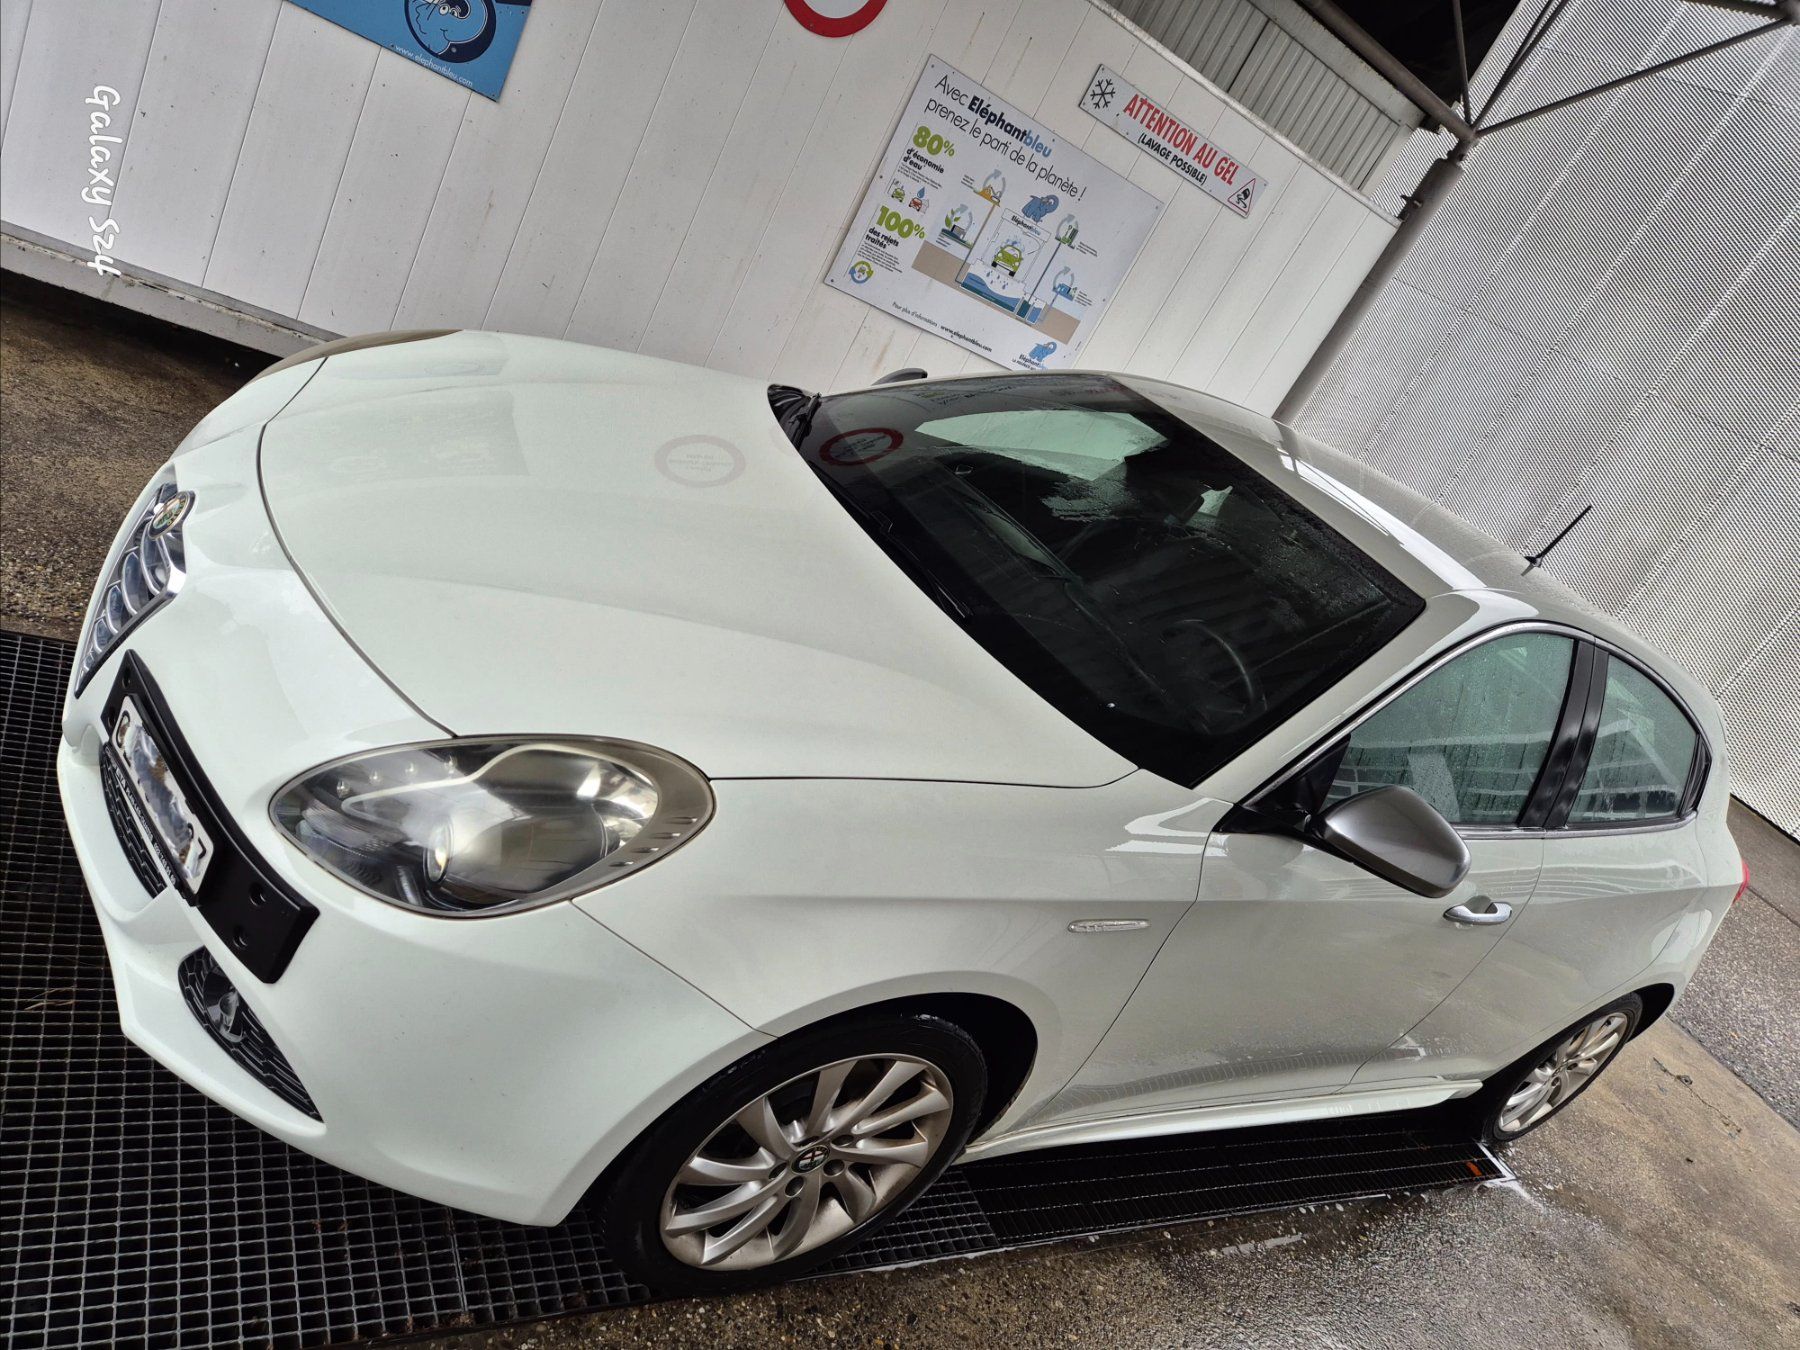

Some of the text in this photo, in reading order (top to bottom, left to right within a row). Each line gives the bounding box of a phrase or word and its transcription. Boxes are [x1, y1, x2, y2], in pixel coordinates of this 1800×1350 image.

[394, 45, 474, 87] www.elephantbleu.com
[934, 75, 1053, 158] Avec Eléphantbleu
[906, 147, 944, 174] d'économie
[913, 125, 955, 157] 80%
[924, 97, 972, 132] prenez
[969, 118, 982, 139] le
[979, 132, 1012, 156] parti
[1009, 148, 1025, 166] de
[1025, 154, 1037, 174] la
[1035, 165, 1079, 197] planète
[1123, 93, 1240, 186] ATTENTION AU GEL
[1137, 132, 1208, 186] (LAVAGE POSSIBLE)
[868, 227, 899, 247] des rejets
[876, 205, 925, 239] 100%
